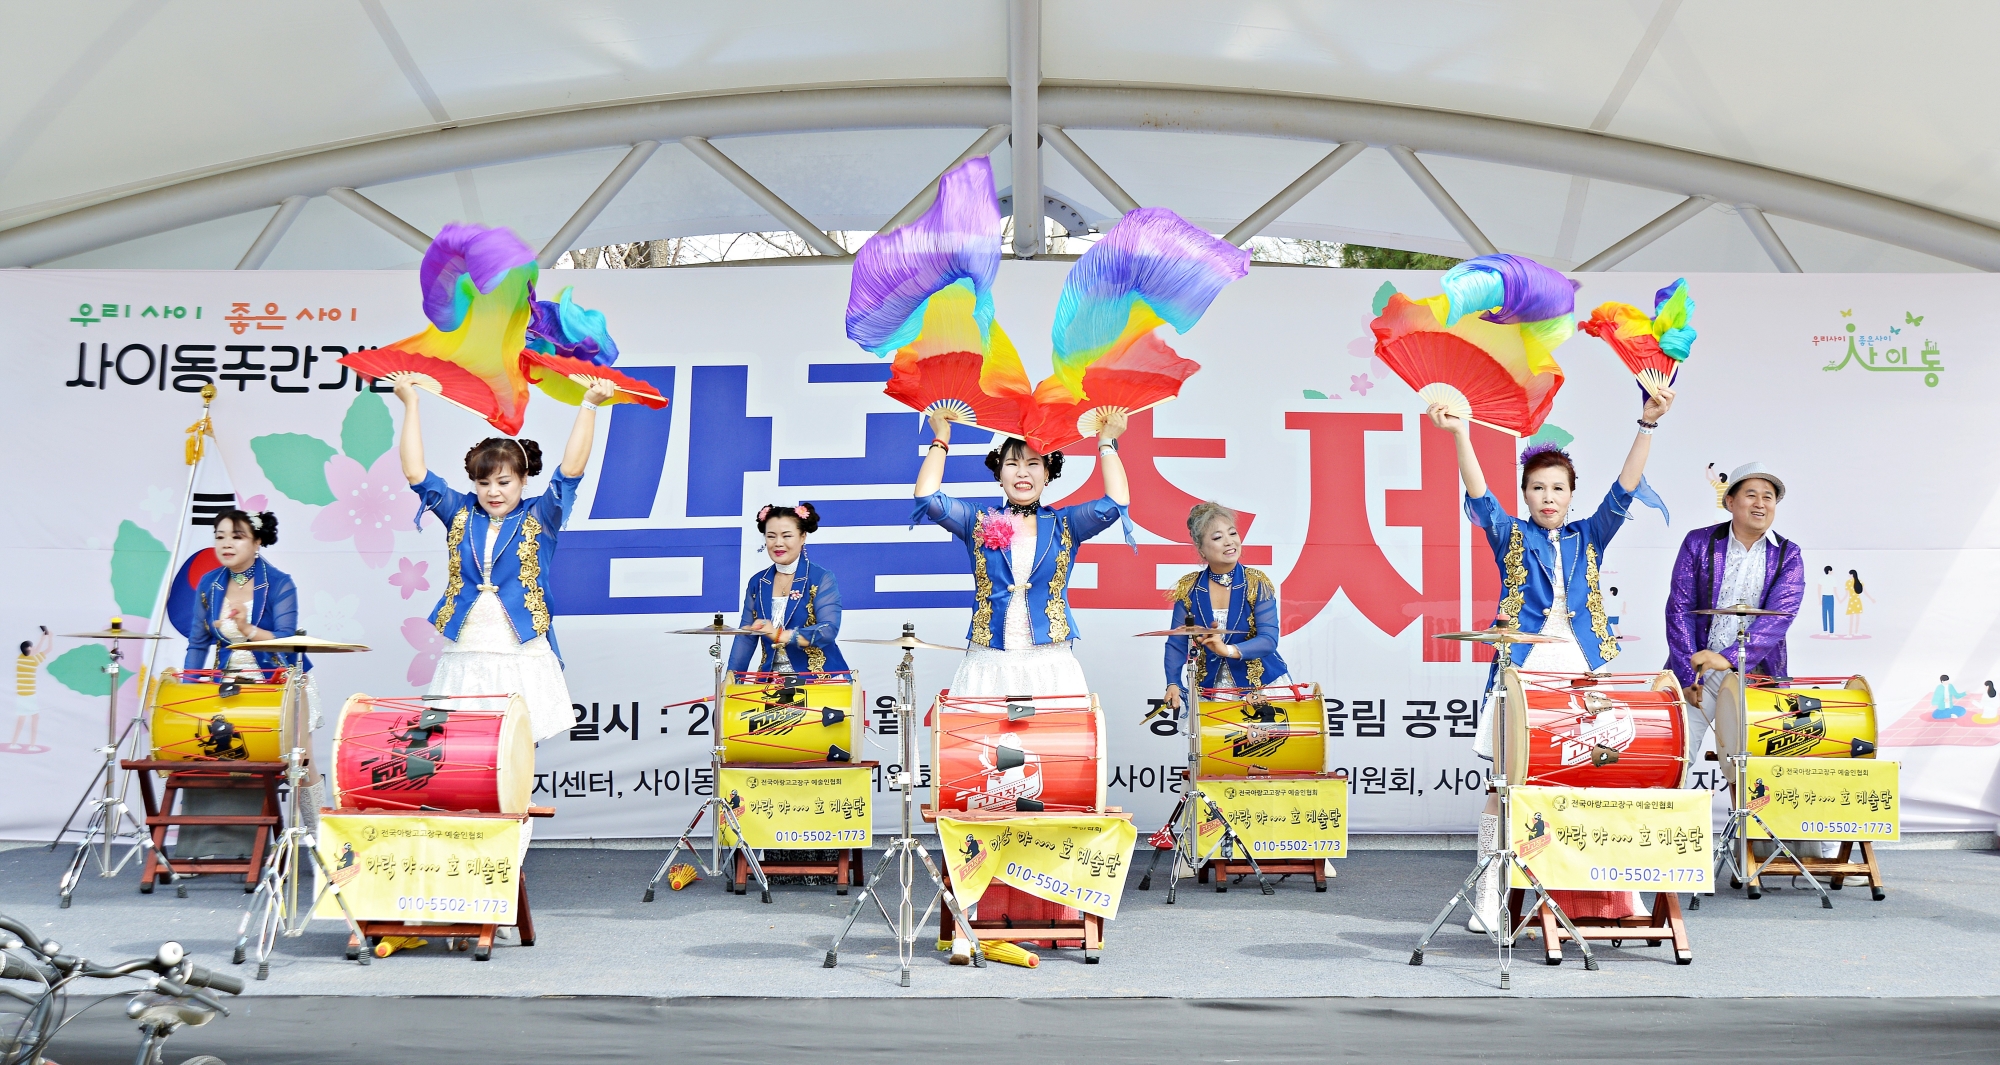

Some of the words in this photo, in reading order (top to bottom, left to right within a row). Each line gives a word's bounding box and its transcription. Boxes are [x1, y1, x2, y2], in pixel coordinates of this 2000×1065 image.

[70, 303, 131, 327] 우리
[141, 305, 202, 319] 사이
[224, 302, 287, 335] 좋은
[296, 307, 357, 321] 사이
[1812, 335, 1846, 346] 우리사이
[1859, 335, 1892, 346] 좋은사이
[1839, 323, 1945, 388] 사이동
[65, 341, 395, 393] 사이동주간기
[1402, 699, 1478, 738] 공원
[811, 778, 842, 787] 예술인협회
[1838, 768, 1869, 777] 예술인협회
[1288, 789, 1318, 797] 예술인협회
[1840, 788, 1850, 806] 호
[1855, 789, 1893, 812] 예술단
[814, 797, 825, 815] 호
[829, 796, 866, 820] 예술단
[1635, 799, 1674, 810] 예술인협회
[1290, 807, 1301, 825] 호
[1305, 808, 1342, 830] 예술단
[1801, 821, 1892, 834] 010-5502-1773
[445, 830, 484, 840] 예술인협회
[776, 830, 866, 842] 010-5502-1773
[1638, 823, 1651, 847] 호
[1657, 825, 1704, 855] 예술단
[1254, 841, 1341, 852] 010-5502-1773
[1059, 837, 1073, 860] 호
[1077, 846, 1121, 878] 예술단
[447, 854, 459, 876] 호
[467, 856, 511, 885] 예술단
[1590, 867, 1704, 882] 010-5502-1773
[1006, 862, 1111, 907] 010-5502-1773
[398, 896, 509, 913] 010-5502-1773
